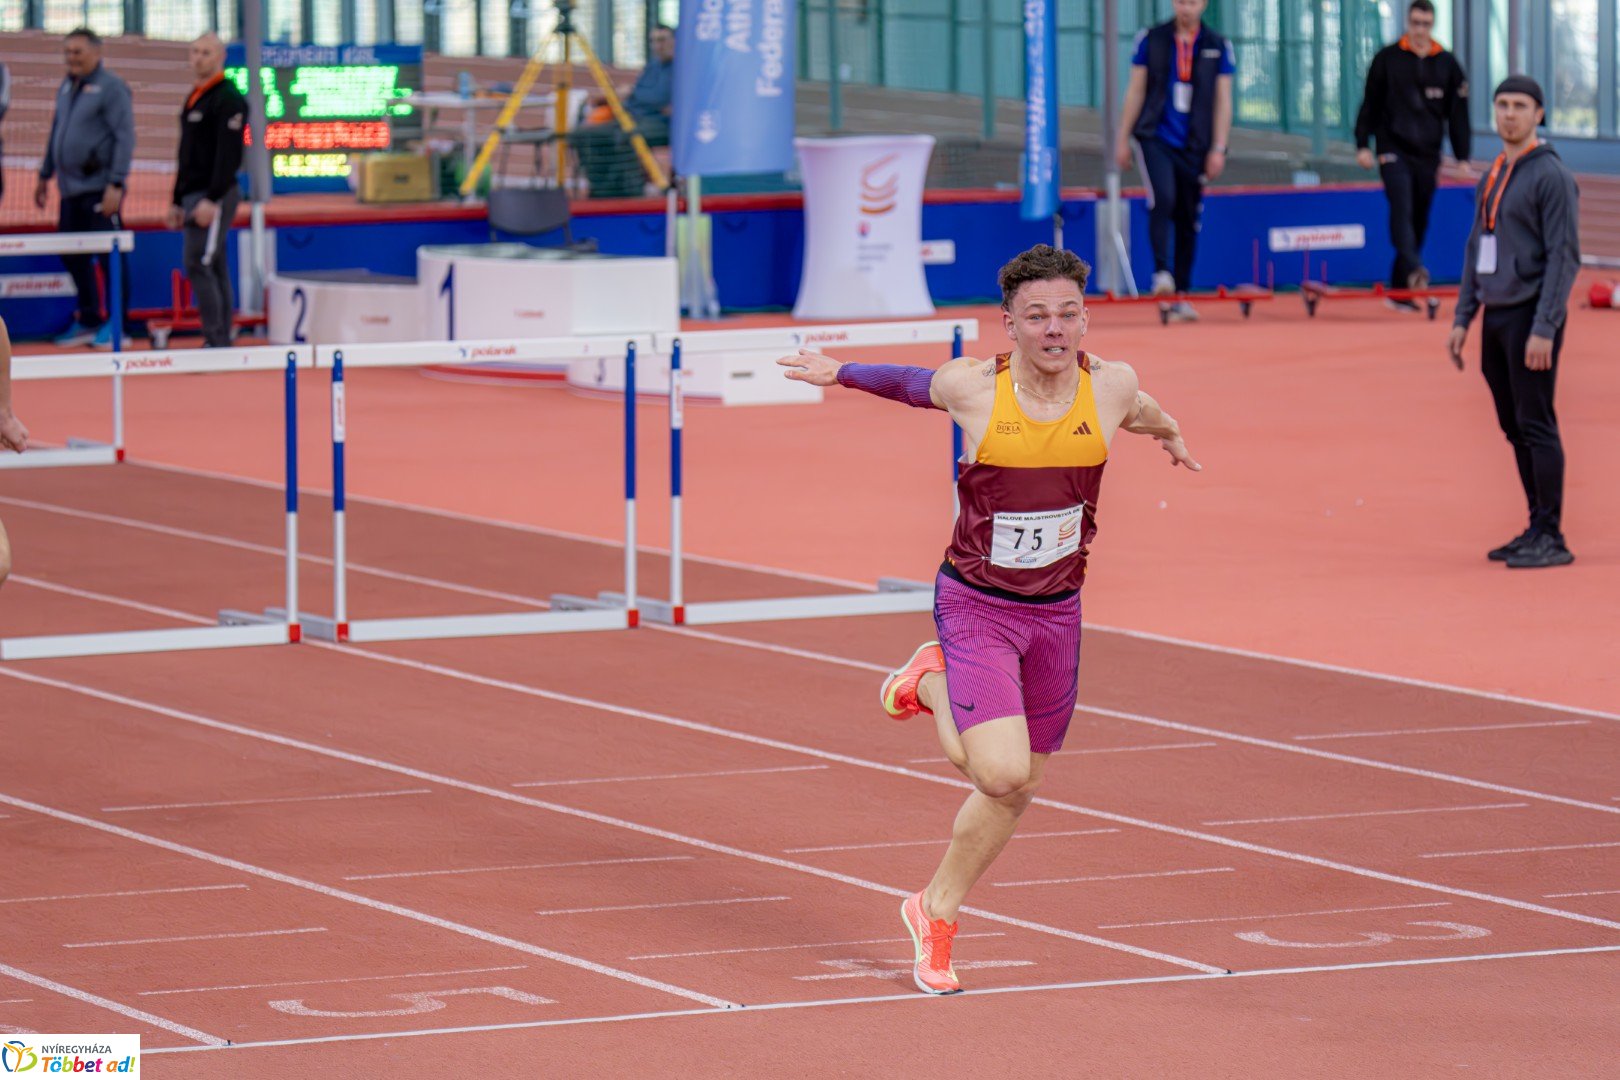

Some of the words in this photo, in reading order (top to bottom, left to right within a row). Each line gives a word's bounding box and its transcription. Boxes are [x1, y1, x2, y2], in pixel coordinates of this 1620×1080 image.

[291, 287, 307, 343] 2
[439, 262, 455, 341] 1
[996, 424, 1021, 433] DUKLA
[1233, 921, 1492, 949] 3
[267, 986, 560, 1018] 5
